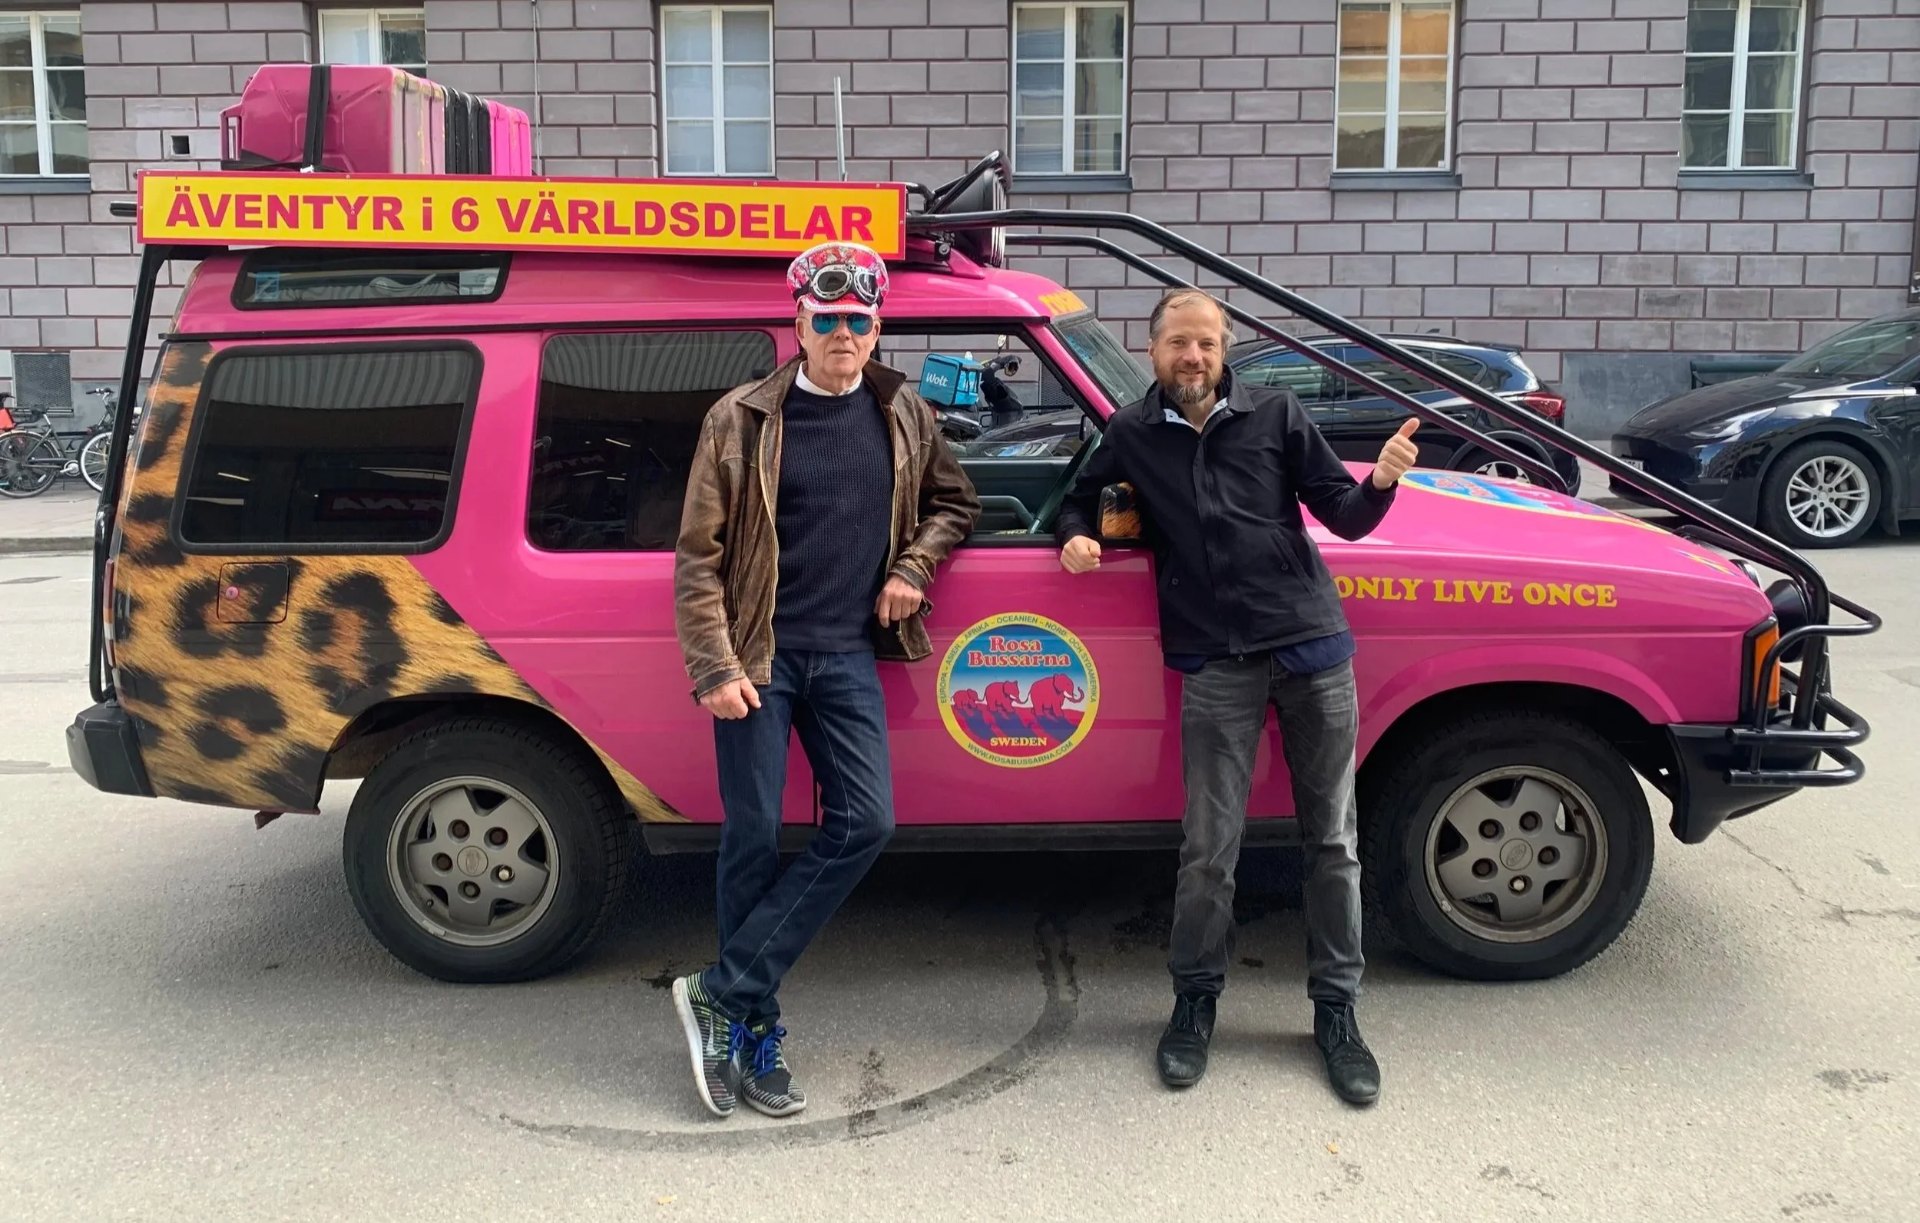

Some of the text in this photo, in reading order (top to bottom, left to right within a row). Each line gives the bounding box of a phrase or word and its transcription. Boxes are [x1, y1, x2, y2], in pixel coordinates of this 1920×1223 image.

[165, 185, 875, 241] ÄVENTYR i 6 VÄRLDSDELAR
[925, 371, 949, 388] Wolt
[1334, 575, 1618, 608] ONLY LIVE ONCE
[996, 615, 1038, 625] OCEANIEN
[989, 636, 1042, 653] Rosa
[967, 650, 1071, 667] Bussarna
[990, 736, 1048, 747] SWEDEN
